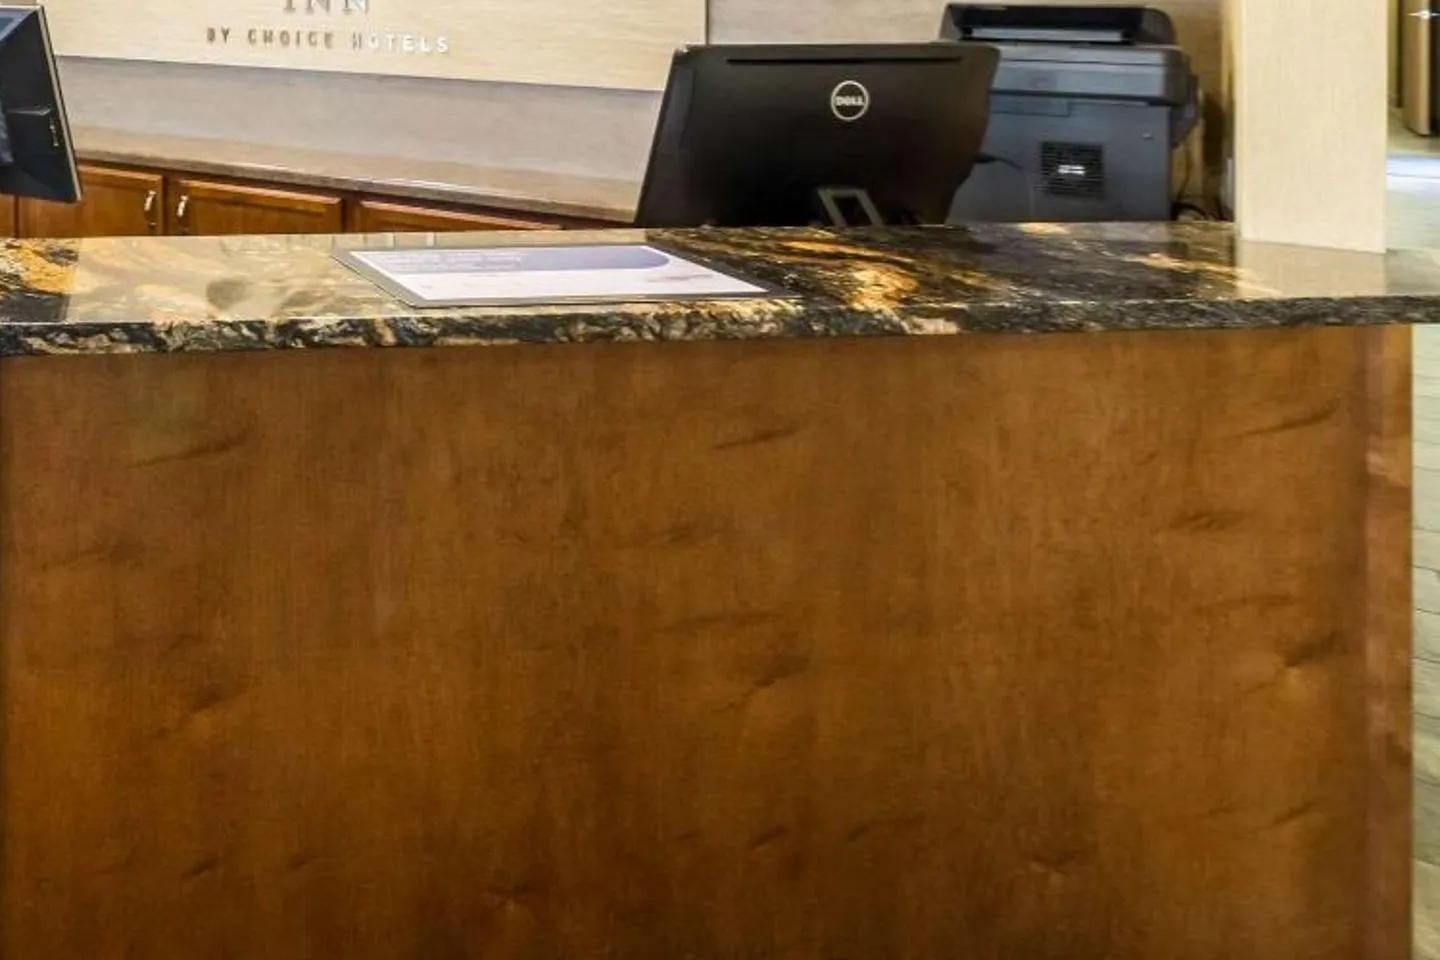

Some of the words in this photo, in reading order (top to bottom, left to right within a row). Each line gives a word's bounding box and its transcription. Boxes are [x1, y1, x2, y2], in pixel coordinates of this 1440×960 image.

[207, 27, 230, 43] BY
[248, 28, 334, 48] CHOICE
[352, 33, 449, 53] HOTELS
[835, 95, 864, 106] DELL
